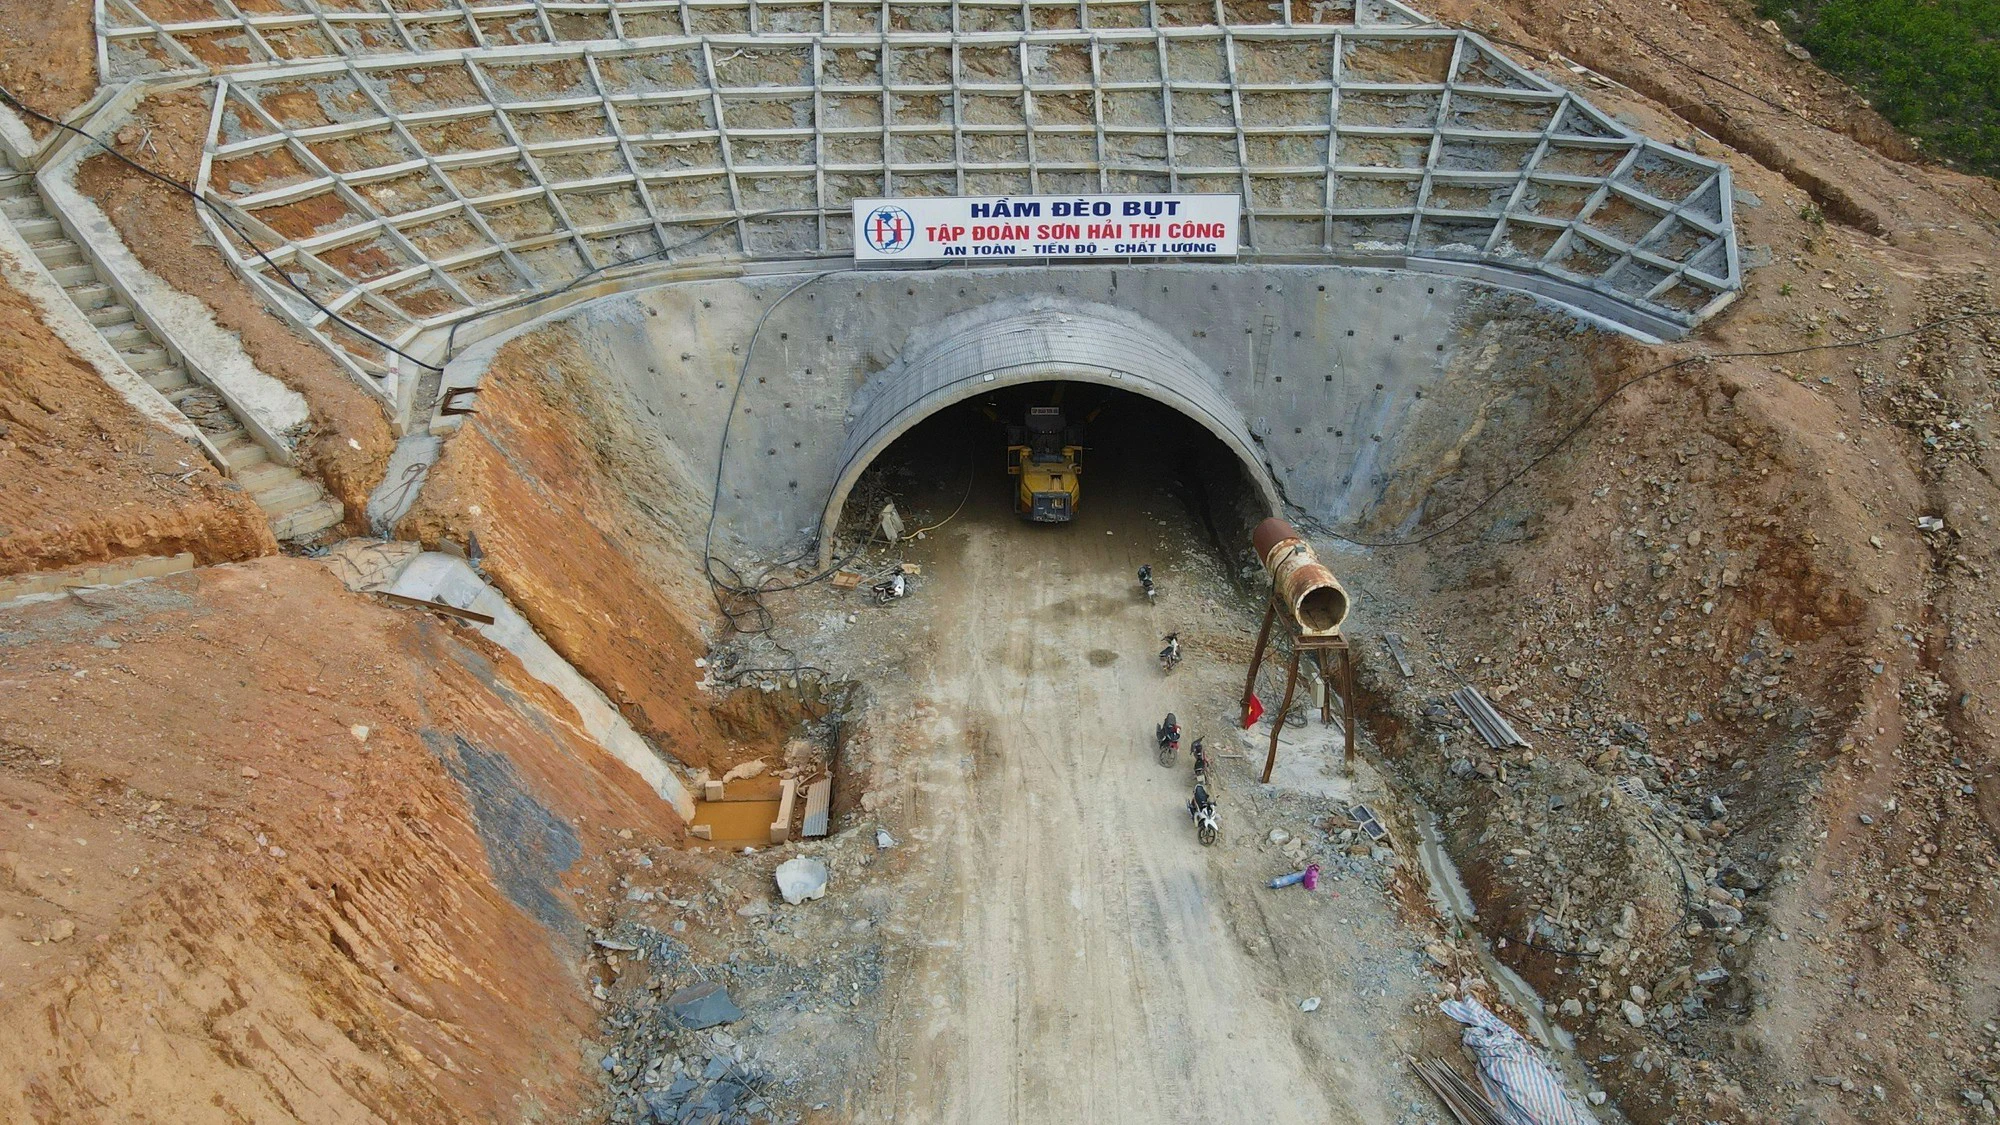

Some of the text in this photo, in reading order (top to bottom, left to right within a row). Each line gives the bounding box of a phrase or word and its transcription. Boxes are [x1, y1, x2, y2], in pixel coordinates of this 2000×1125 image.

[971, 198, 1181, 219] HẦM ĐÈO BỤT
[926, 219, 1225, 245] TẬP ĐOÀN SƠN HẢI THI CÔNG
[943, 246, 967, 256] AN
[973, 244, 1016, 255] TOÀN
[1033, 242, 1070, 254] TIẾN
[1075, 242, 1097, 256] ĐỘ
[1114, 240, 1157, 254] CHẤT
[1162, 243, 1217, 255] LƯỢNG
